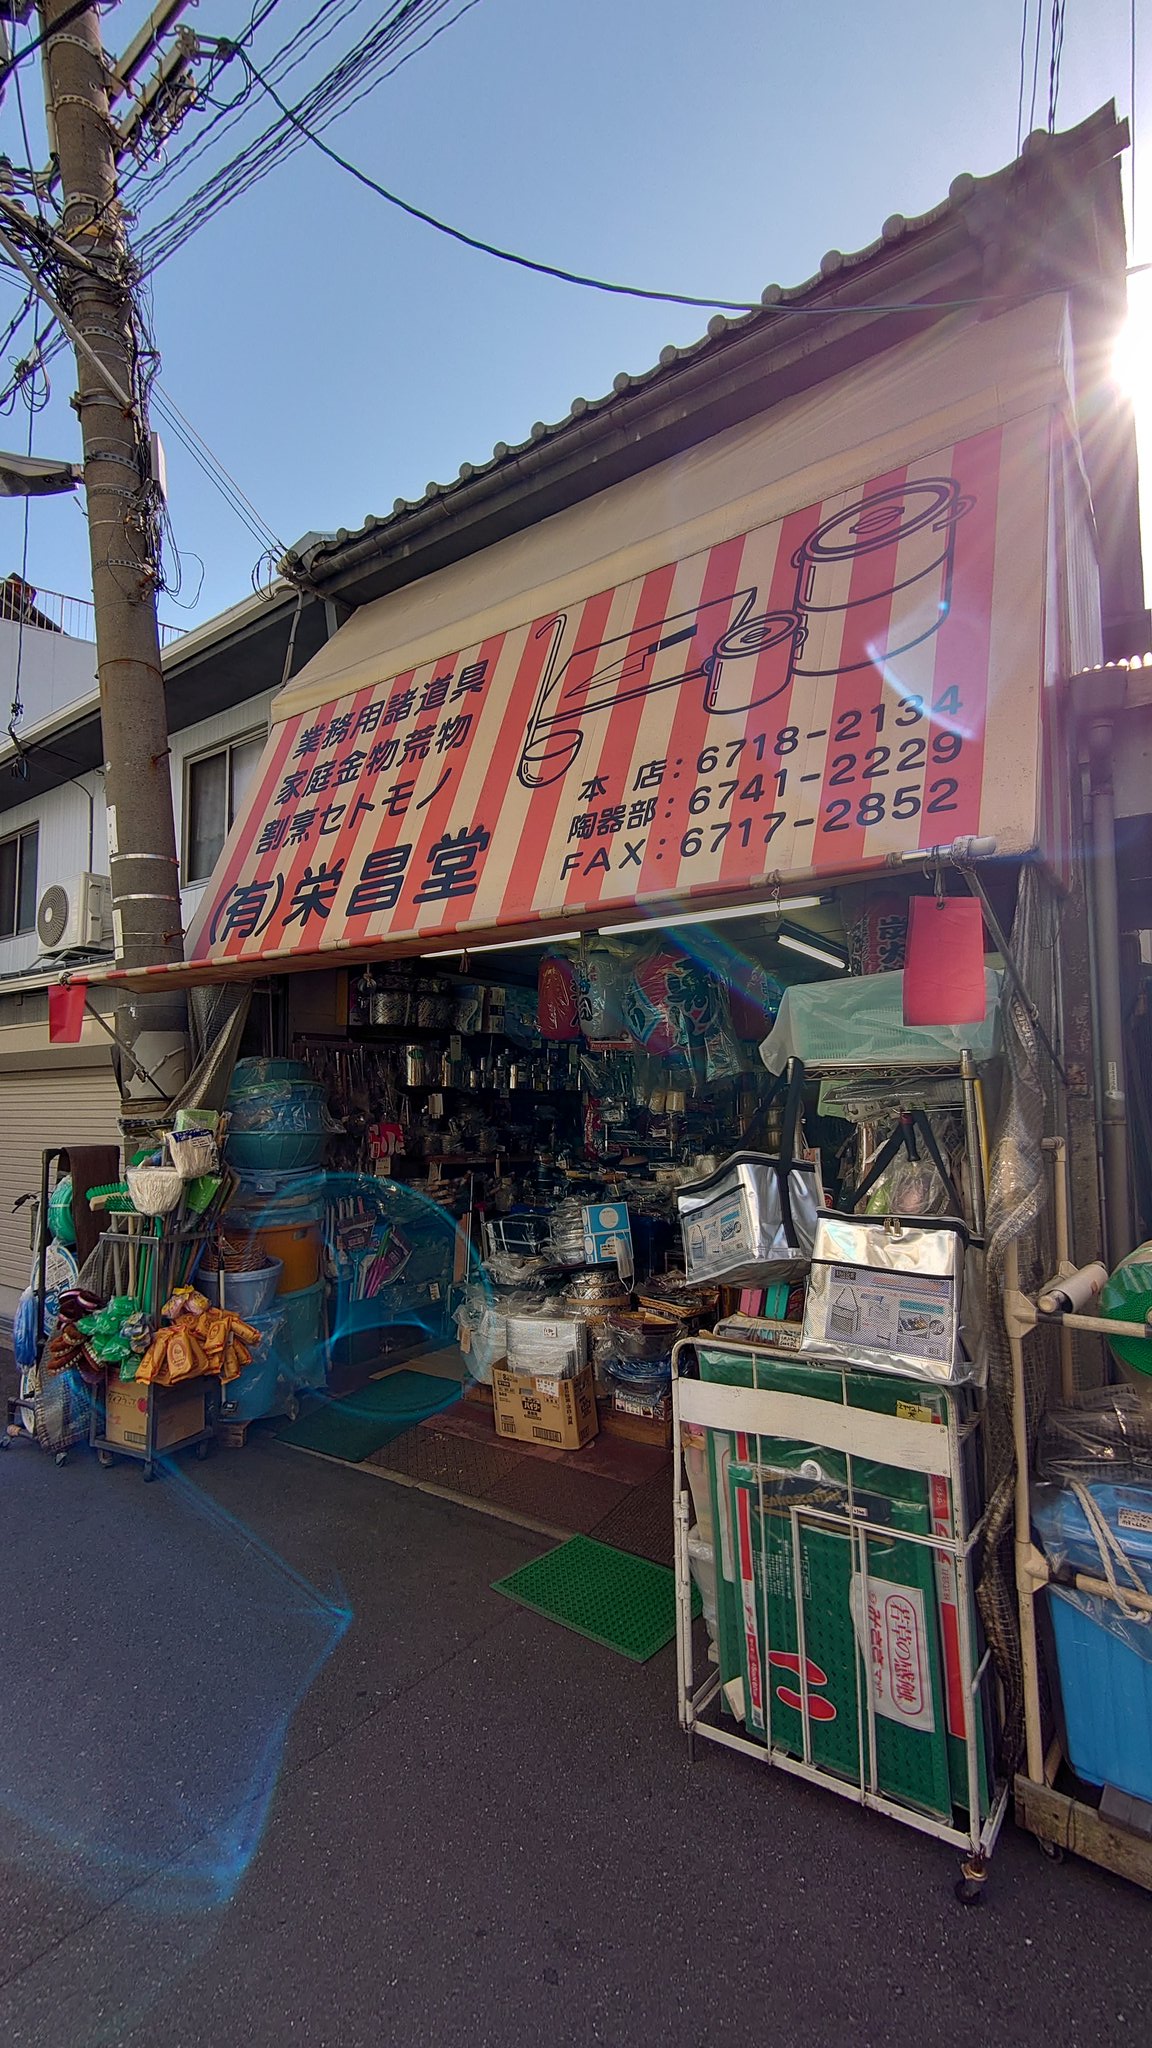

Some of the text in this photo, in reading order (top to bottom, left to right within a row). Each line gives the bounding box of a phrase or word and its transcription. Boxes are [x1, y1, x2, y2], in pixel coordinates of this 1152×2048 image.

[292, 659, 489, 760] 業務用諸道具
[697, 685, 963, 773] 6718-2134
[274, 714, 473, 806] 家庭金物荒物
[688, 730, 962, 815] 6741-2229
[255, 768, 452, 855] 割烹セトモノ
[680, 778, 959, 857] 6717-2852
[210, 824, 491, 945] (有)栄昌堂
[890, 1601, 916, 1702] 若草の感触
